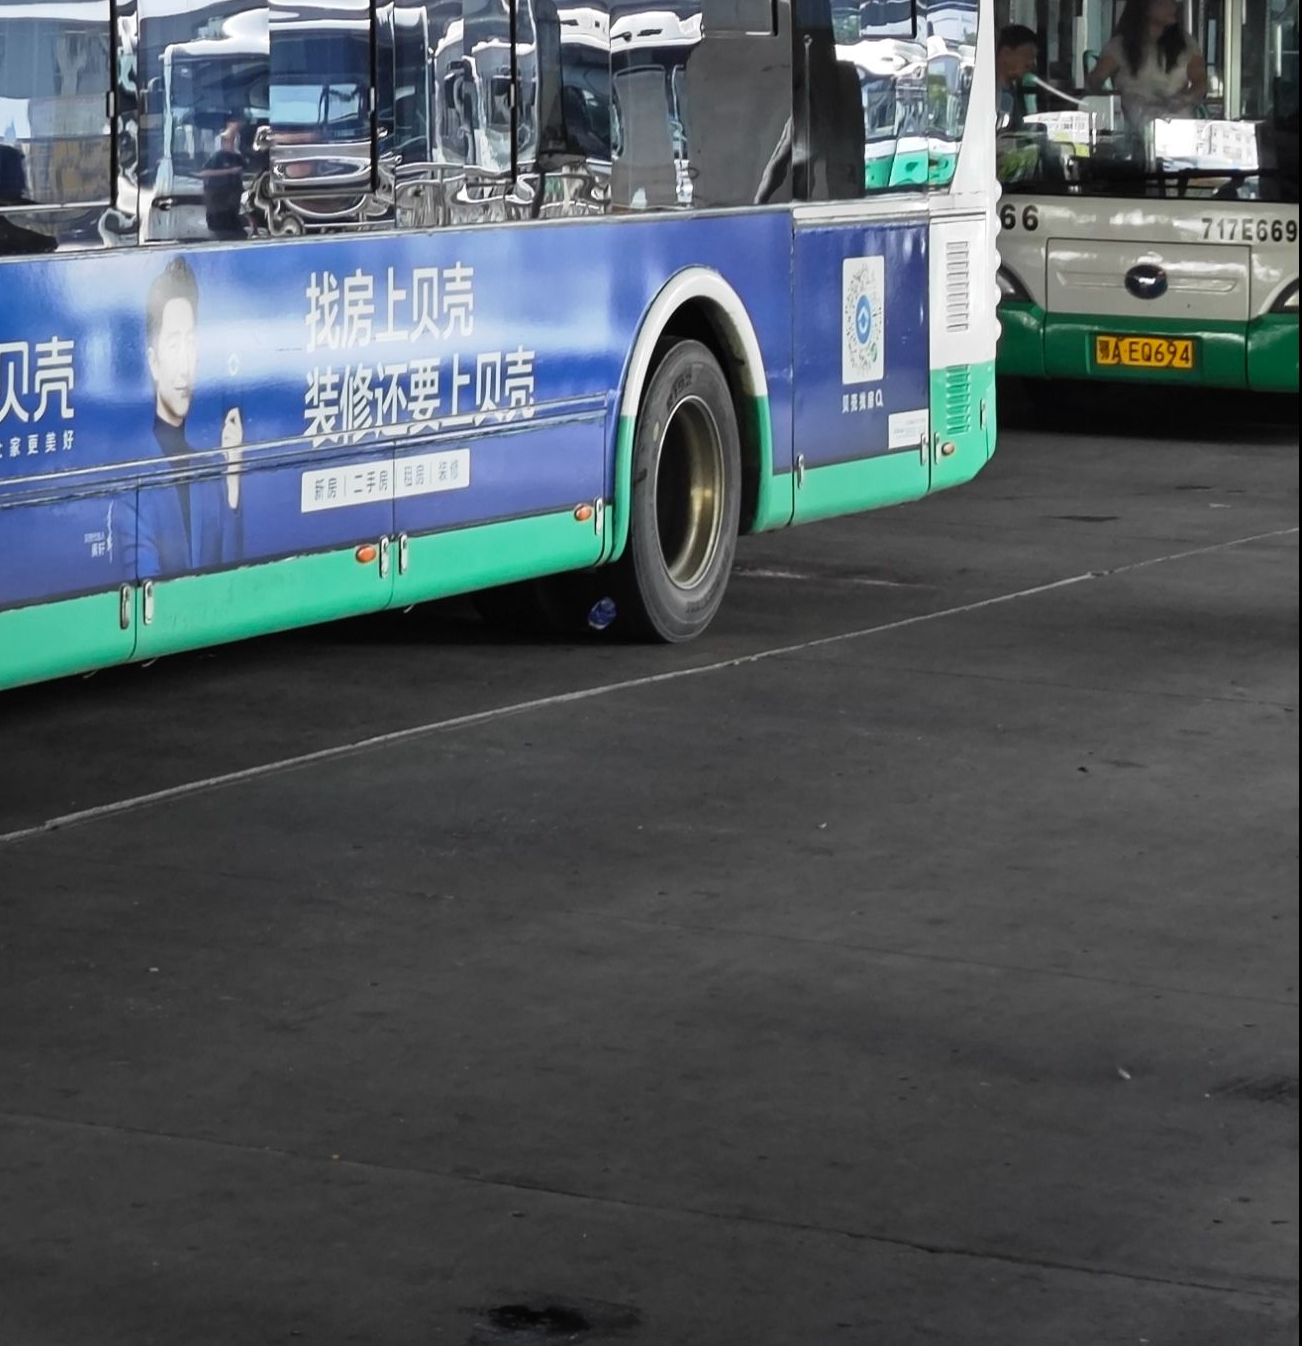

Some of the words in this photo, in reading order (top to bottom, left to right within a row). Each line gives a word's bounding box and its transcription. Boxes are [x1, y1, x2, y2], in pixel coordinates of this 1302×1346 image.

[999, 204, 1039, 231] 66
[1202, 217, 1298, 243] 717E669
[306, 261, 474, 352] 找房上贝壳
[303, 345, 536, 448] 装修还要上贝壳
